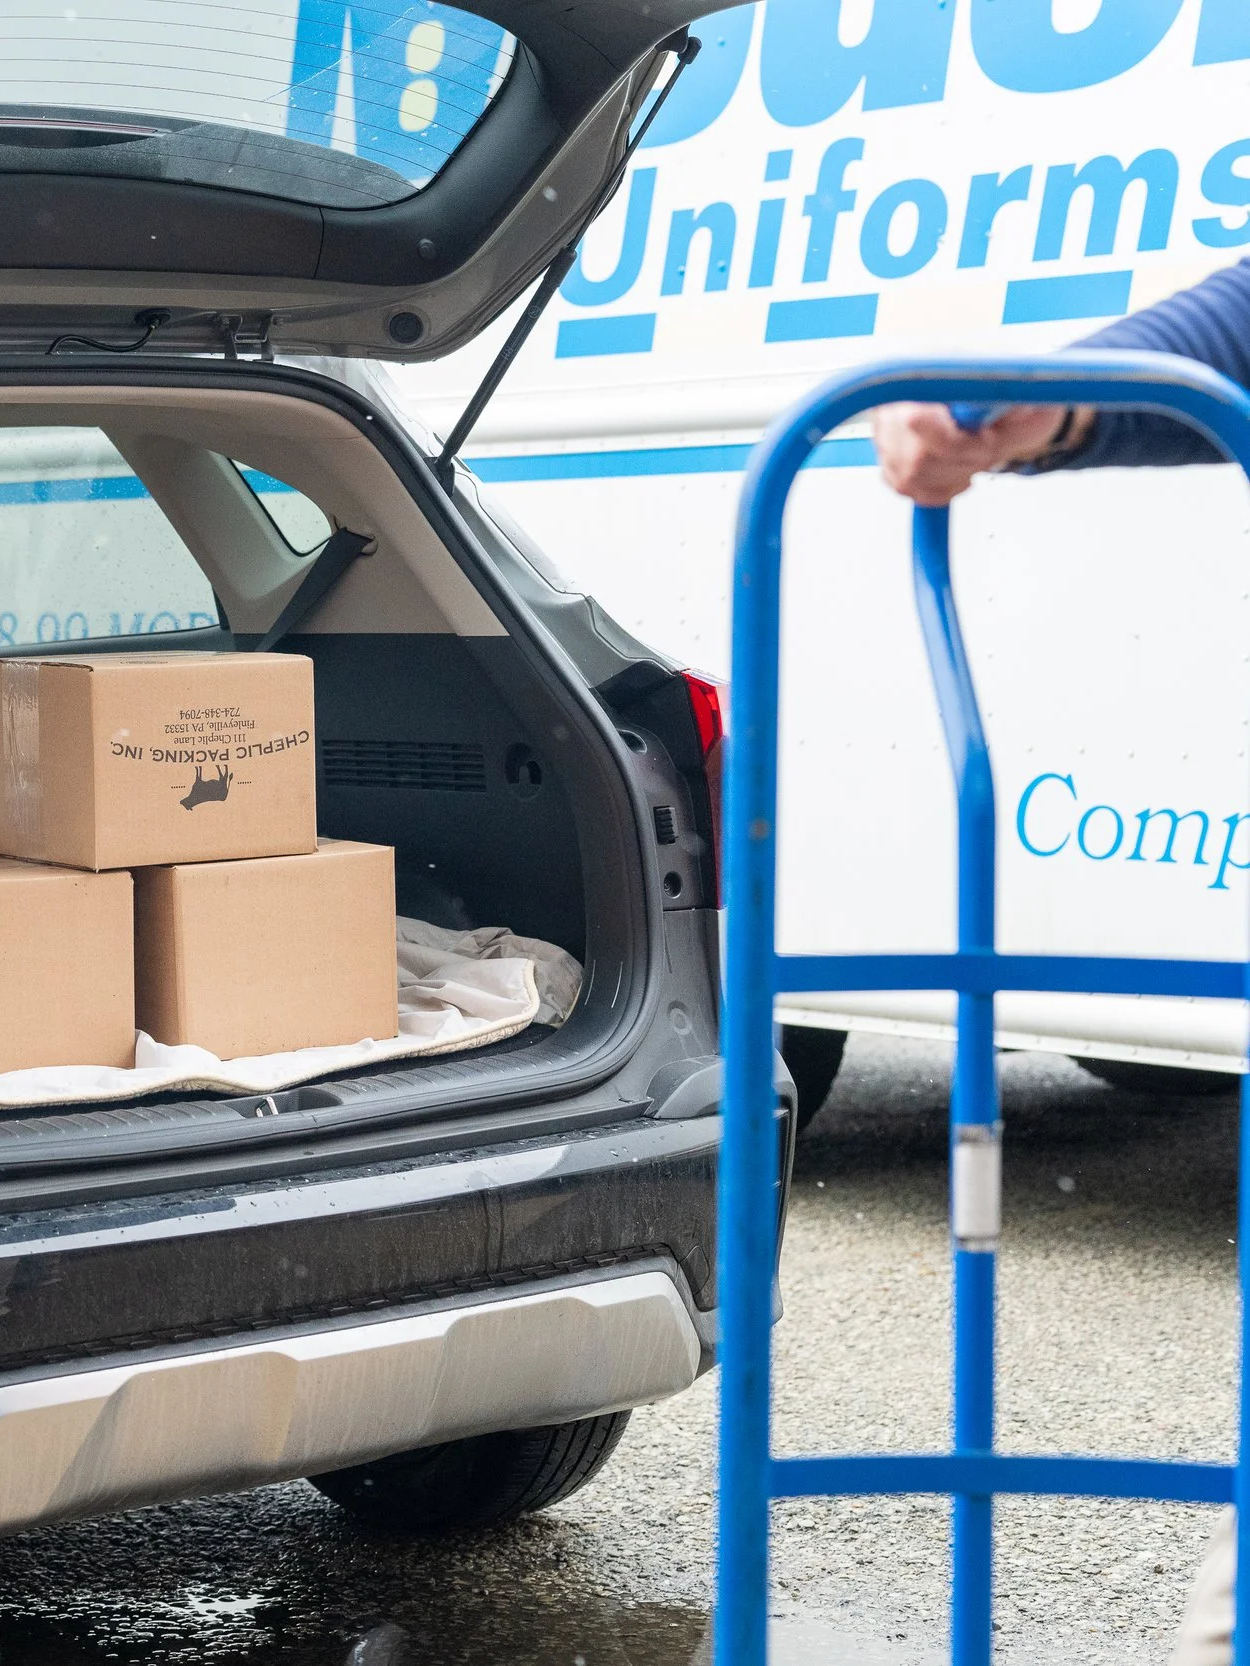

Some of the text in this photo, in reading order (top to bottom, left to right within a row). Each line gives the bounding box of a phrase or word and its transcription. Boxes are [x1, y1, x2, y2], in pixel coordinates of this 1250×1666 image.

[558, 137, 1250, 308] Uniforms
[179, 707, 241, 720] 724-348-7094
[164, 719, 255, 734] Finleyville, PA 15332
[110, 730, 310, 763] CHEPLIC PACKING, INC.
[173, 733, 247, 746] 111 Cheplic Lane
